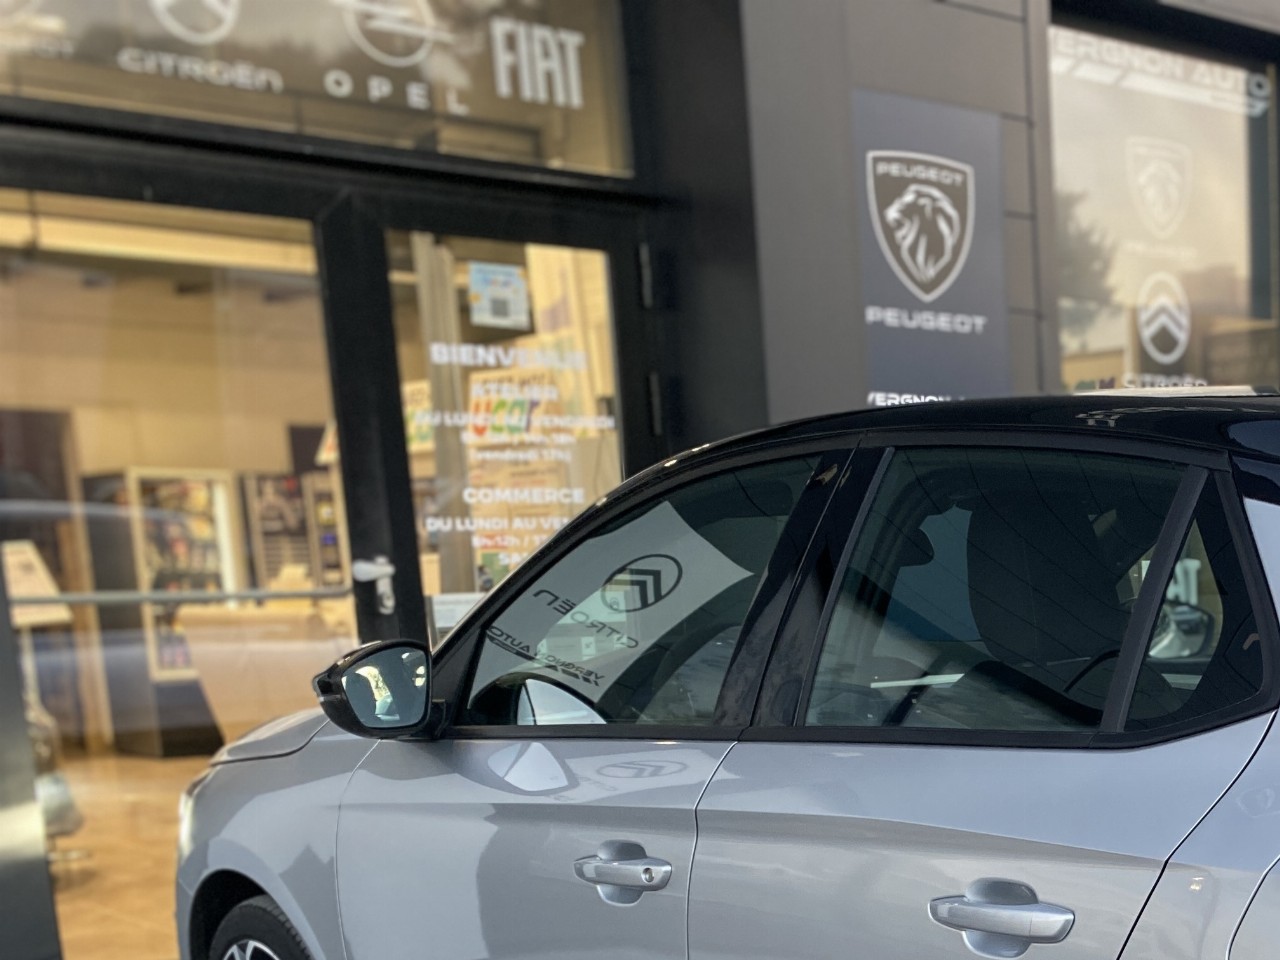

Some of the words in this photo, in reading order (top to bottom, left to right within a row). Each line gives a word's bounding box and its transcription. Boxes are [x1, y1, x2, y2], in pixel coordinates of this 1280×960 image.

[489, 17, 585, 110] FIAT
[323, 69, 471, 117] OPEL
[875, 161, 965, 188] PEUGEOT
[864, 305, 988, 335] PEUGEOT
[429, 342, 587, 371] BIENVENUE
[462, 487, 586, 505] COMMERCE
[425, 516, 453, 533] DU
[455, 516, 509, 532] LUNDI
[511, 517, 538, 531] AU
